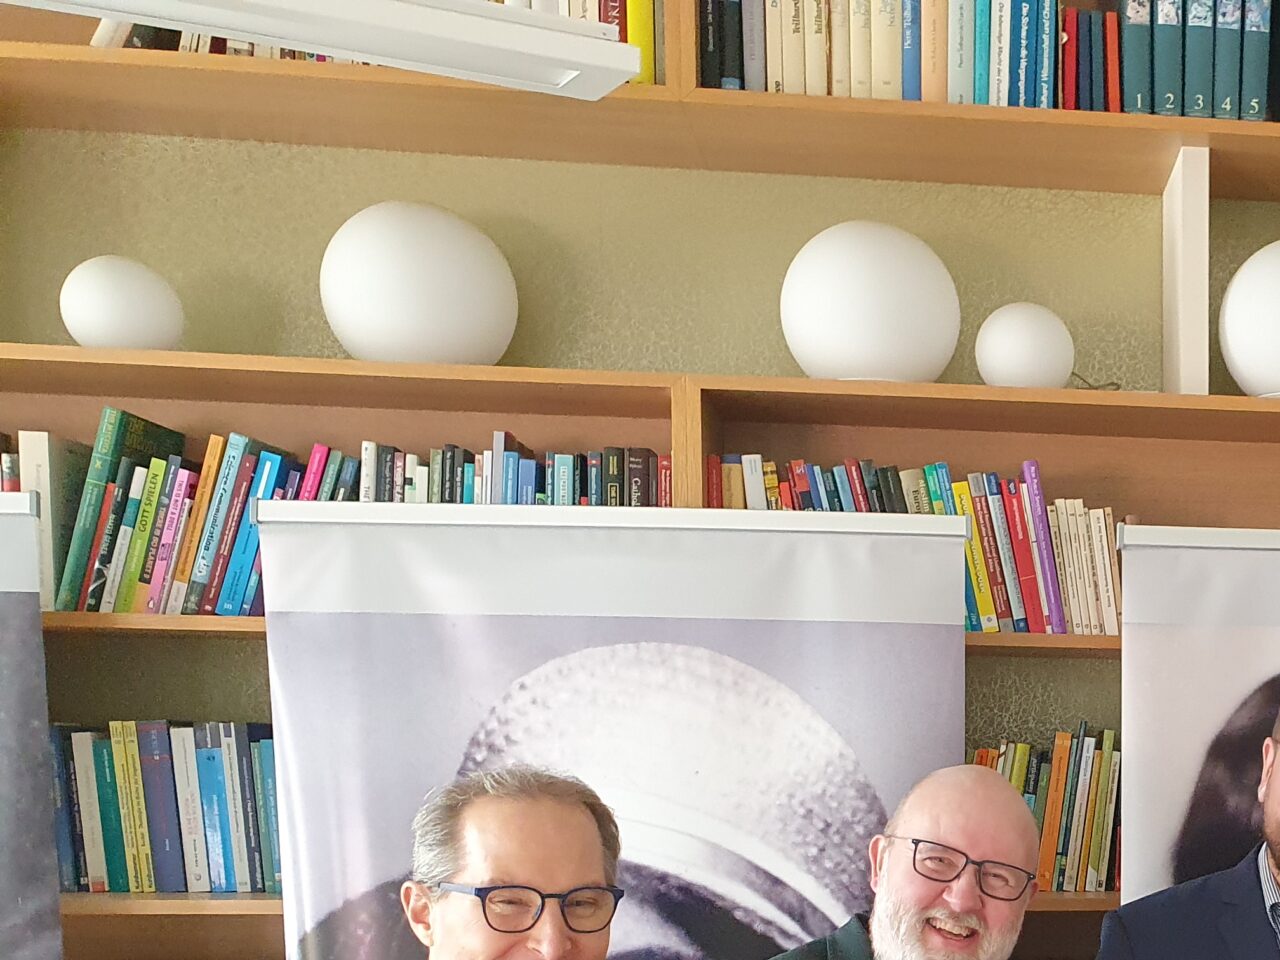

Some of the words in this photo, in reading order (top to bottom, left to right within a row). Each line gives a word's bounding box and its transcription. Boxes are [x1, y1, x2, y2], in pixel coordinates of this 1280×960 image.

[1136, 93, 1142, 109] 1
[1165, 93, 1175, 109] 2
[1194, 95, 1204, 110] 3
[1221, 96, 1232, 111] 4
[1250, 99, 1260, 114] 5
[143, 472, 160, 507] SPIELEN
[136, 508, 151, 532] GOTT
